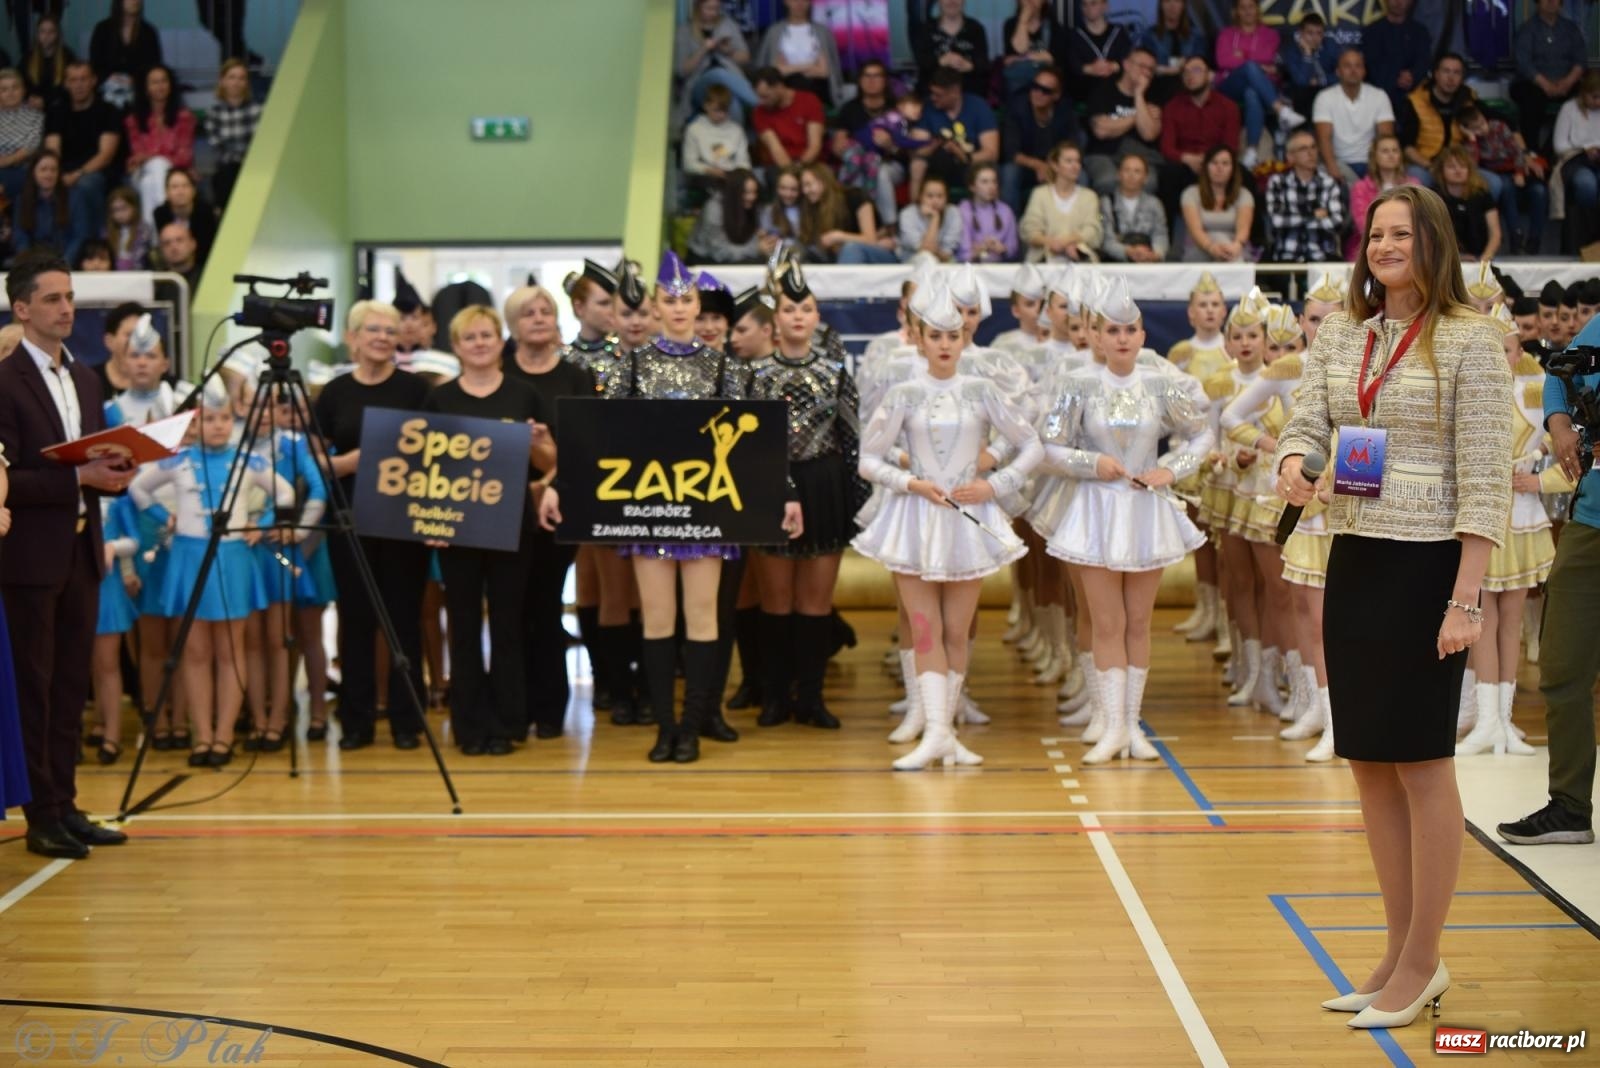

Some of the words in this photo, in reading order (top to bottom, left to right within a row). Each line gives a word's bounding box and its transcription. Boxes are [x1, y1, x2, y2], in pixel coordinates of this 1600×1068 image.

[398, 417, 493, 468] Spec
[377, 456, 503, 505] Babcie
[596, 457, 743, 511] ZARA
[407, 502, 465, 522] Racibórz
[623, 503, 692, 518] RACIBÓRZ
[412, 519, 456, 538] Polska
[592, 523, 650, 537] ZAWADA
[652, 524, 722, 540] KSIĄŻĘCA
